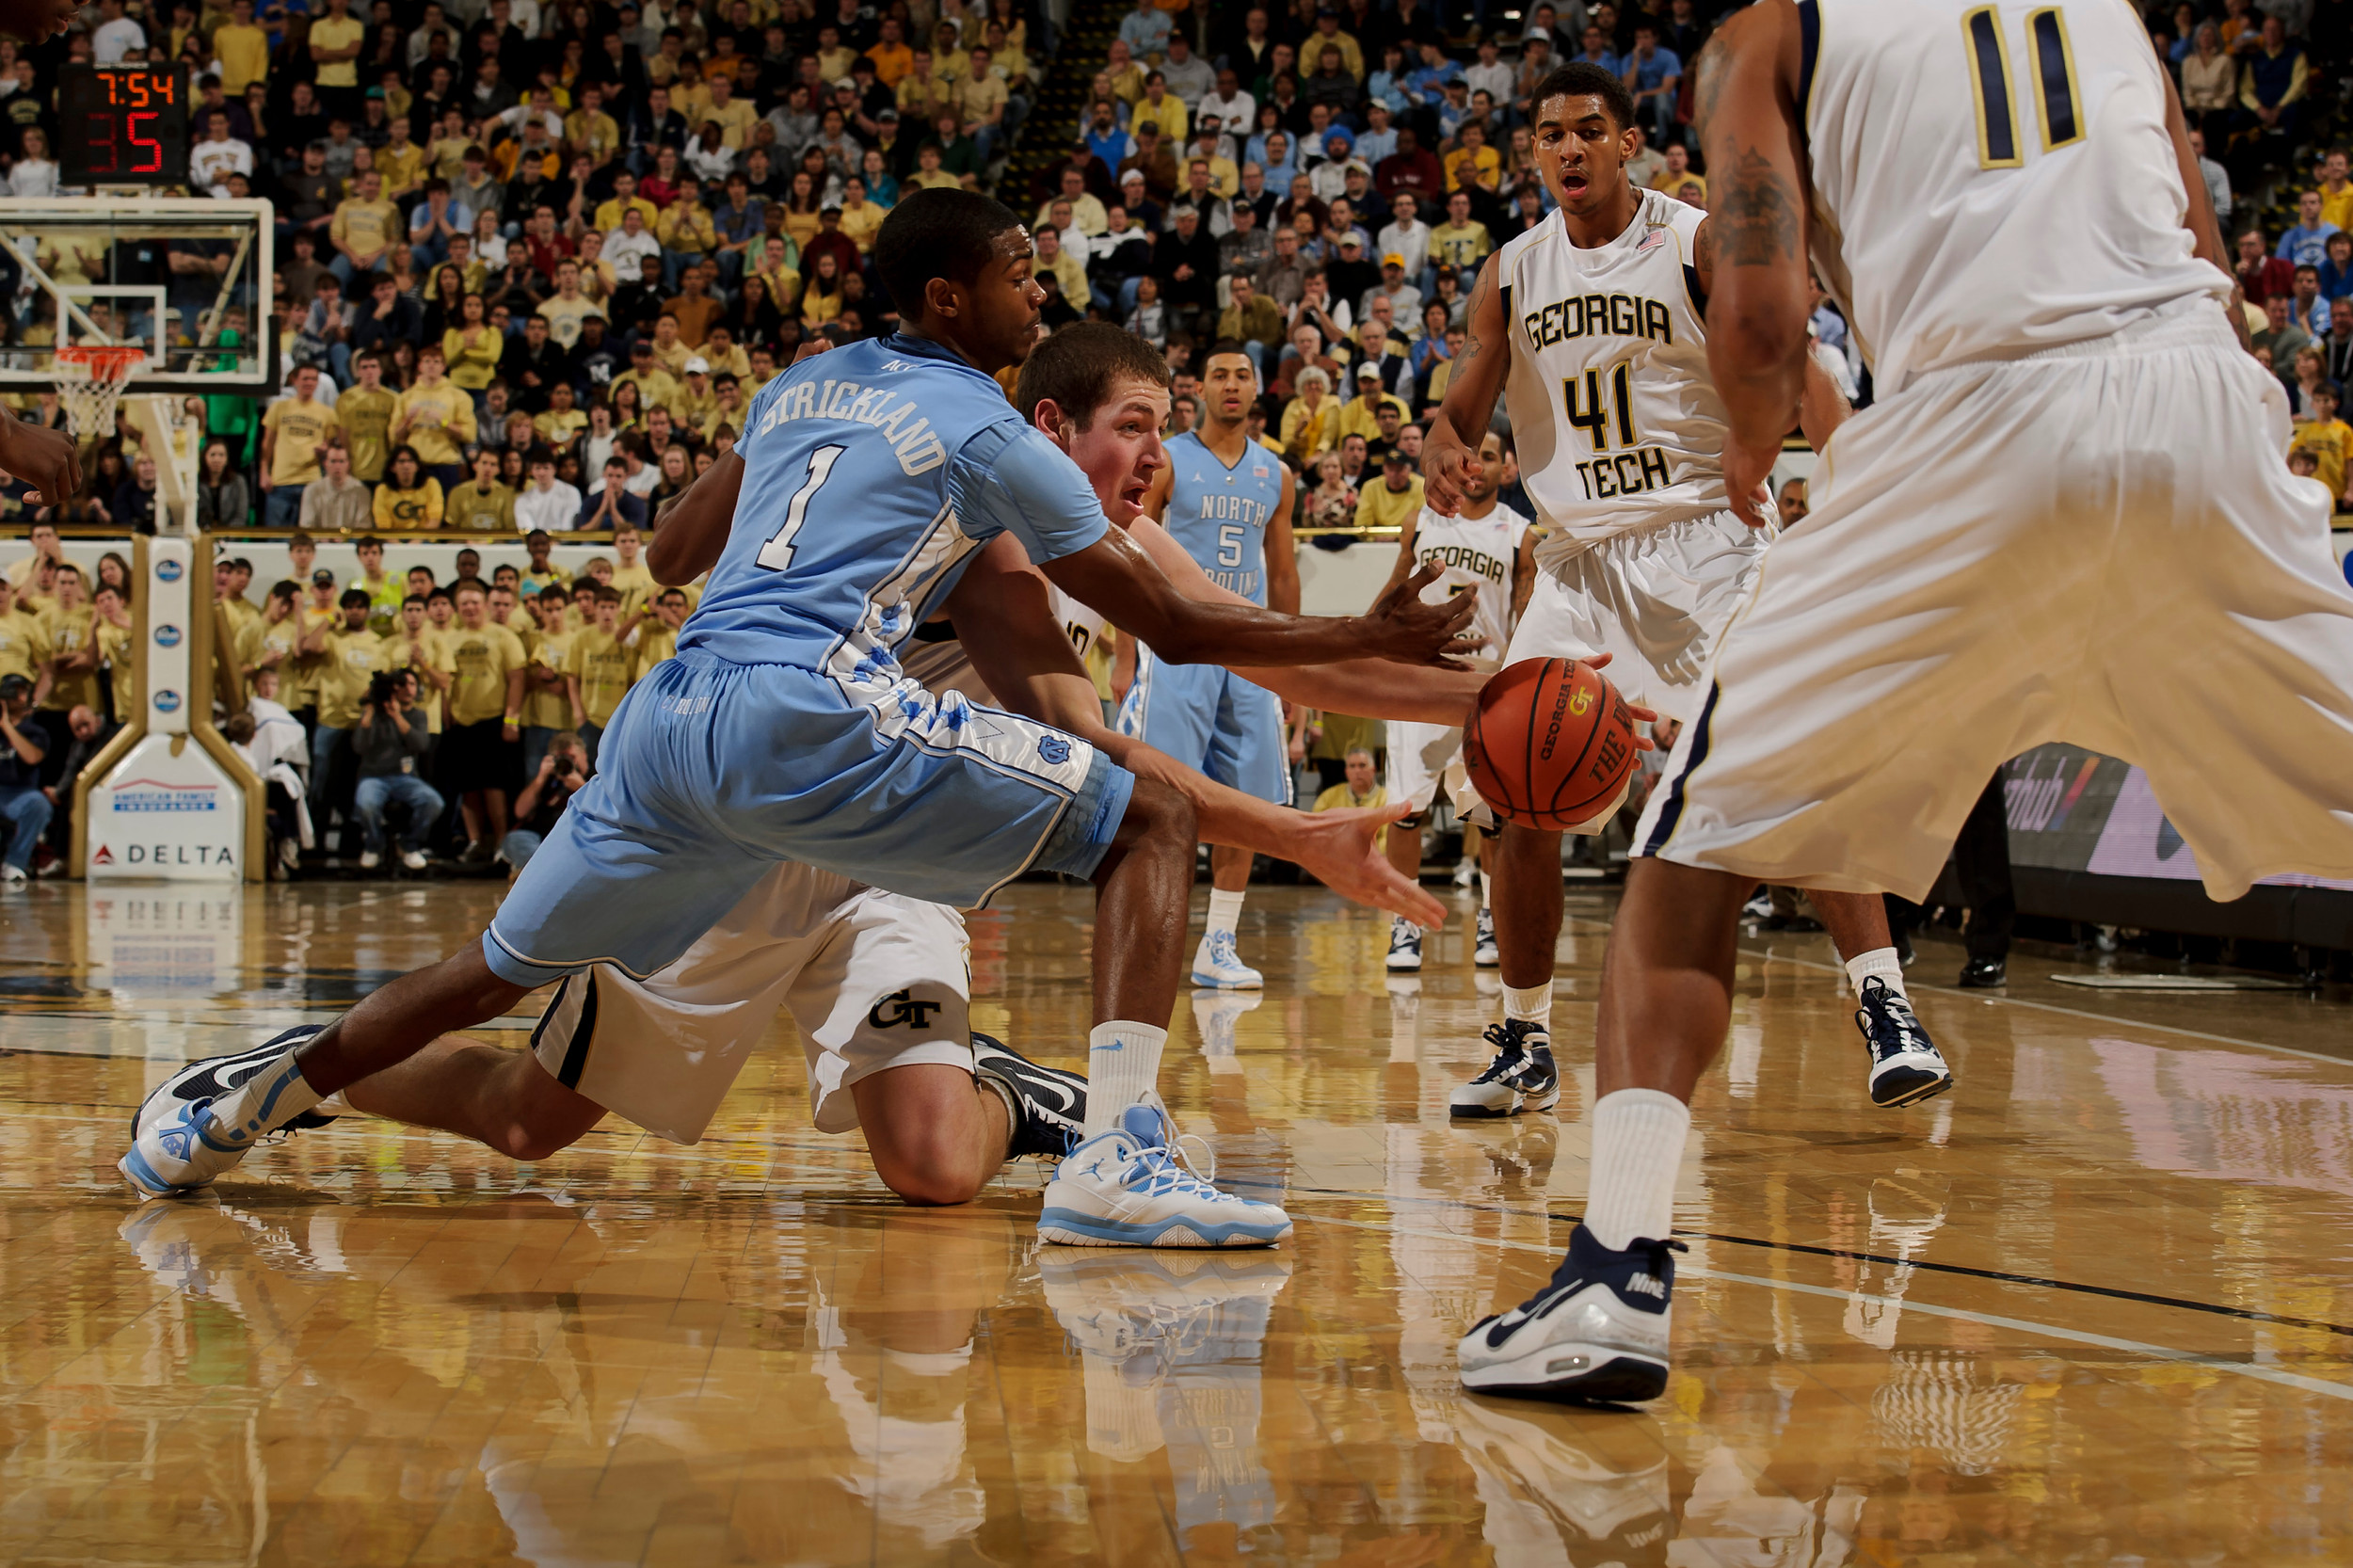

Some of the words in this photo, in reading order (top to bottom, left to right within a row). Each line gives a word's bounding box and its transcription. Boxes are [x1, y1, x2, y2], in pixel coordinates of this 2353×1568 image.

[97, 72, 173, 107] 7:54
[1961, 3, 2087, 170] 11
[1525, 294, 1673, 353] GEORGIA
[760, 379, 947, 476] STRICKLAND
[1562, 359, 1639, 453] 41
[1575, 446, 1671, 499] TECH
[754, 443, 849, 572] 1
[1200, 495, 1267, 528] NORTH
[1218, 523, 1245, 568] 5
[1420, 547, 1504, 584] GEORGIA
[1541, 683, 1572, 761] GEORGIA
[1569, 685, 1593, 716] GT
[1588, 729, 1627, 784] THE
[128, 844, 233, 865] DELTA
[869, 987, 941, 1029] GT
